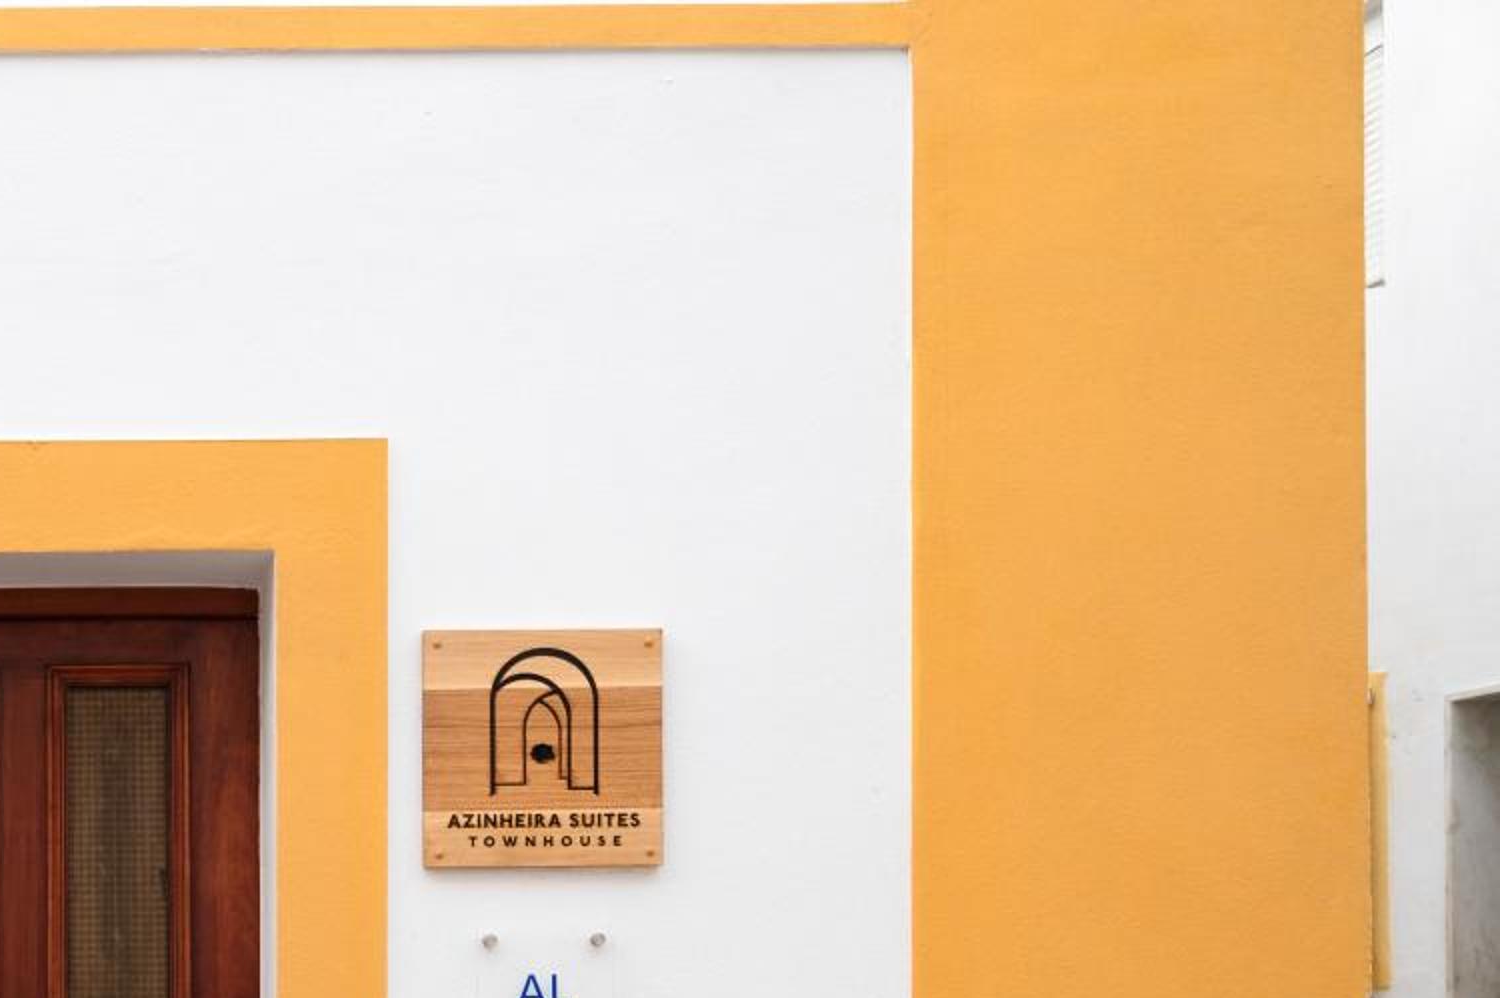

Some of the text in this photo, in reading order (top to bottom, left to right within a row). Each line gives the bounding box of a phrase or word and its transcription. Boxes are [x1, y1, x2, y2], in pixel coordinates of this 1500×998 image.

[448, 813, 640, 829] AZINHEIRA SUITES
[468, 835, 622, 847] TOWNHOUSE
